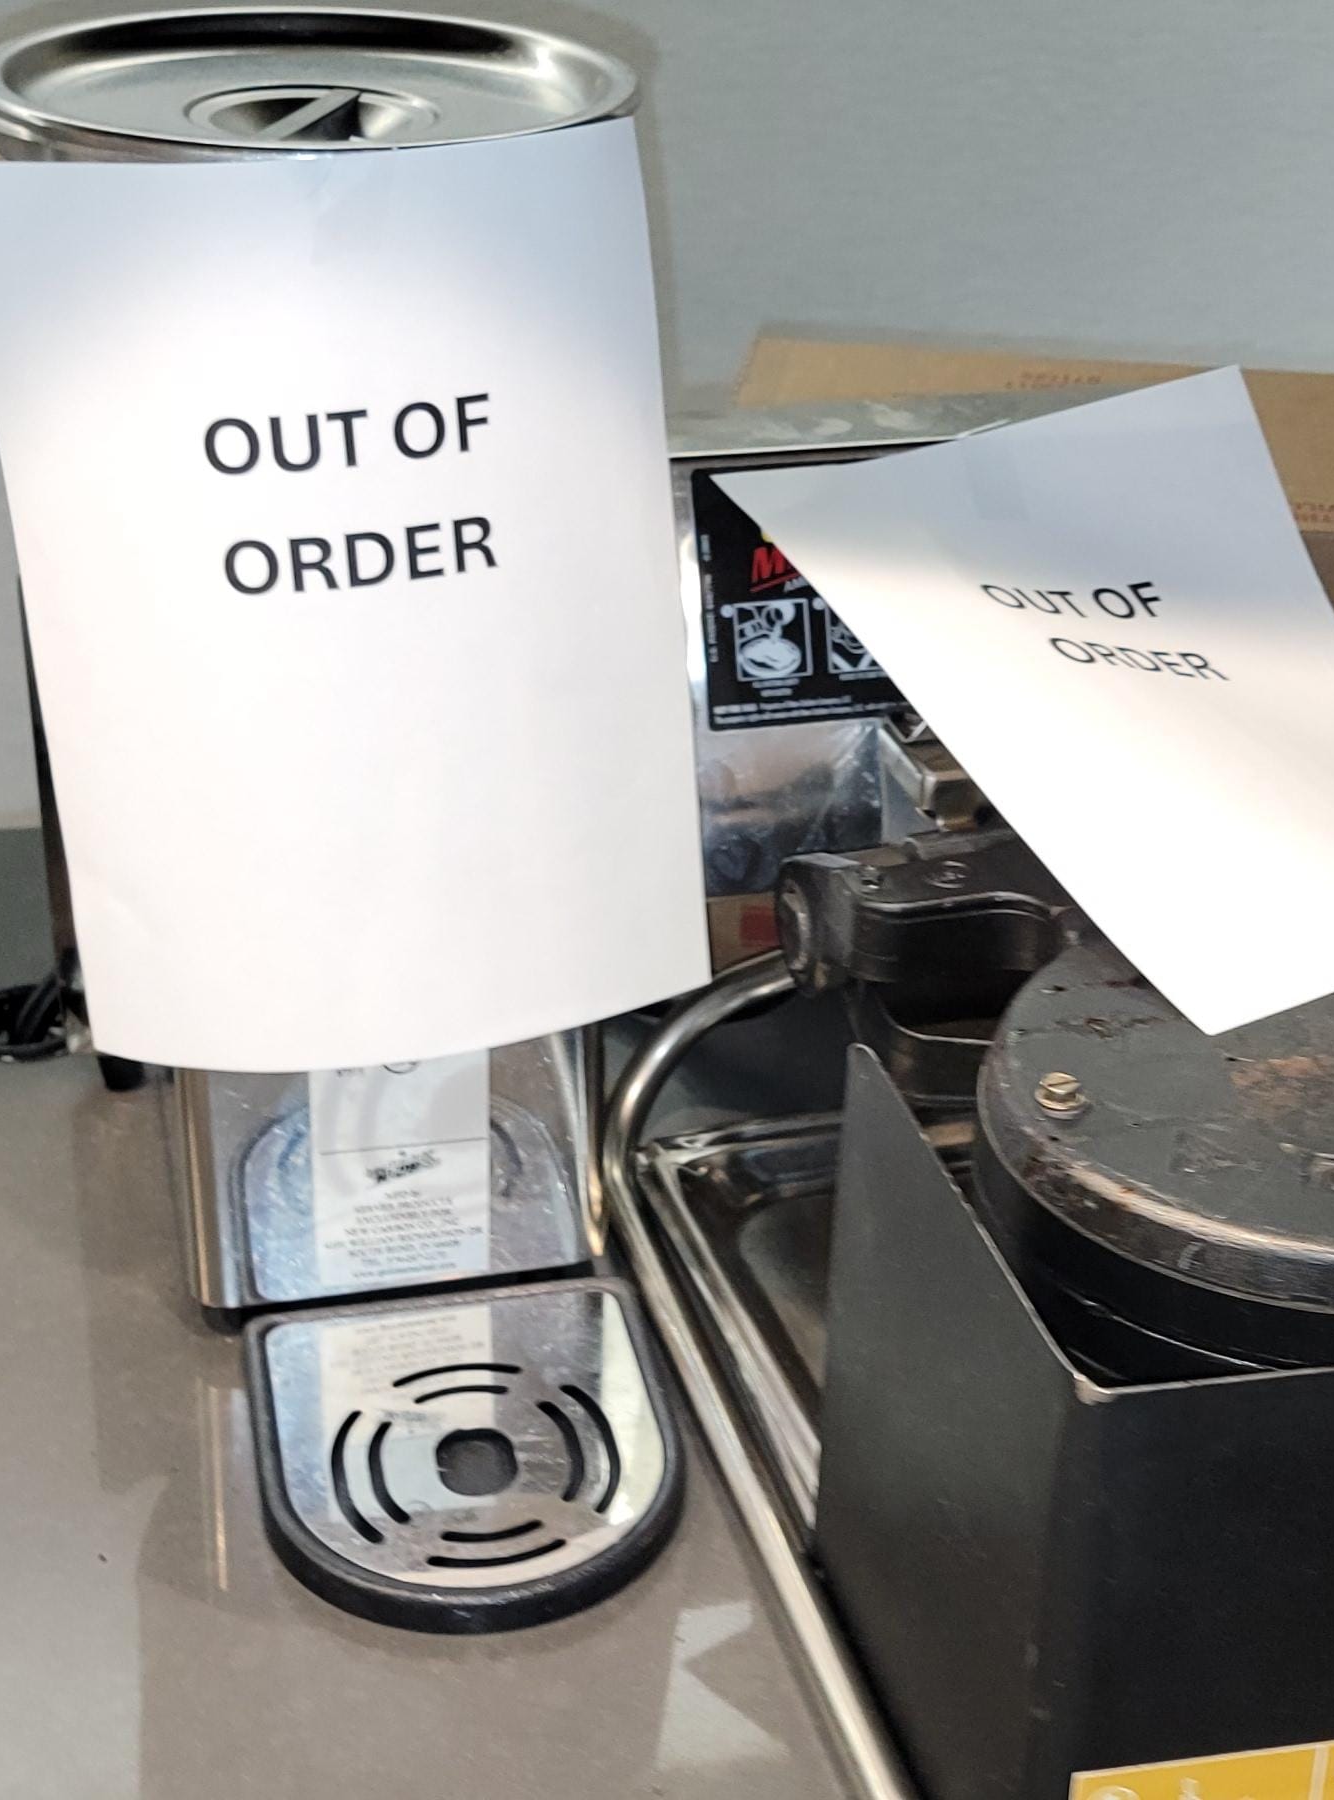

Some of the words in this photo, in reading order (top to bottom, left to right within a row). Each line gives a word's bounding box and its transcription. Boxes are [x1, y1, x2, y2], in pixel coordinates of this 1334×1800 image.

[204, 409, 368, 475] OUT
[393, 393, 489, 460] OF
[224, 516, 498, 595] ORDER
[980, 584, 1088, 618] OUT
[1092, 581, 1162, 619] OF
[1048, 637, 1230, 681] ORDER
